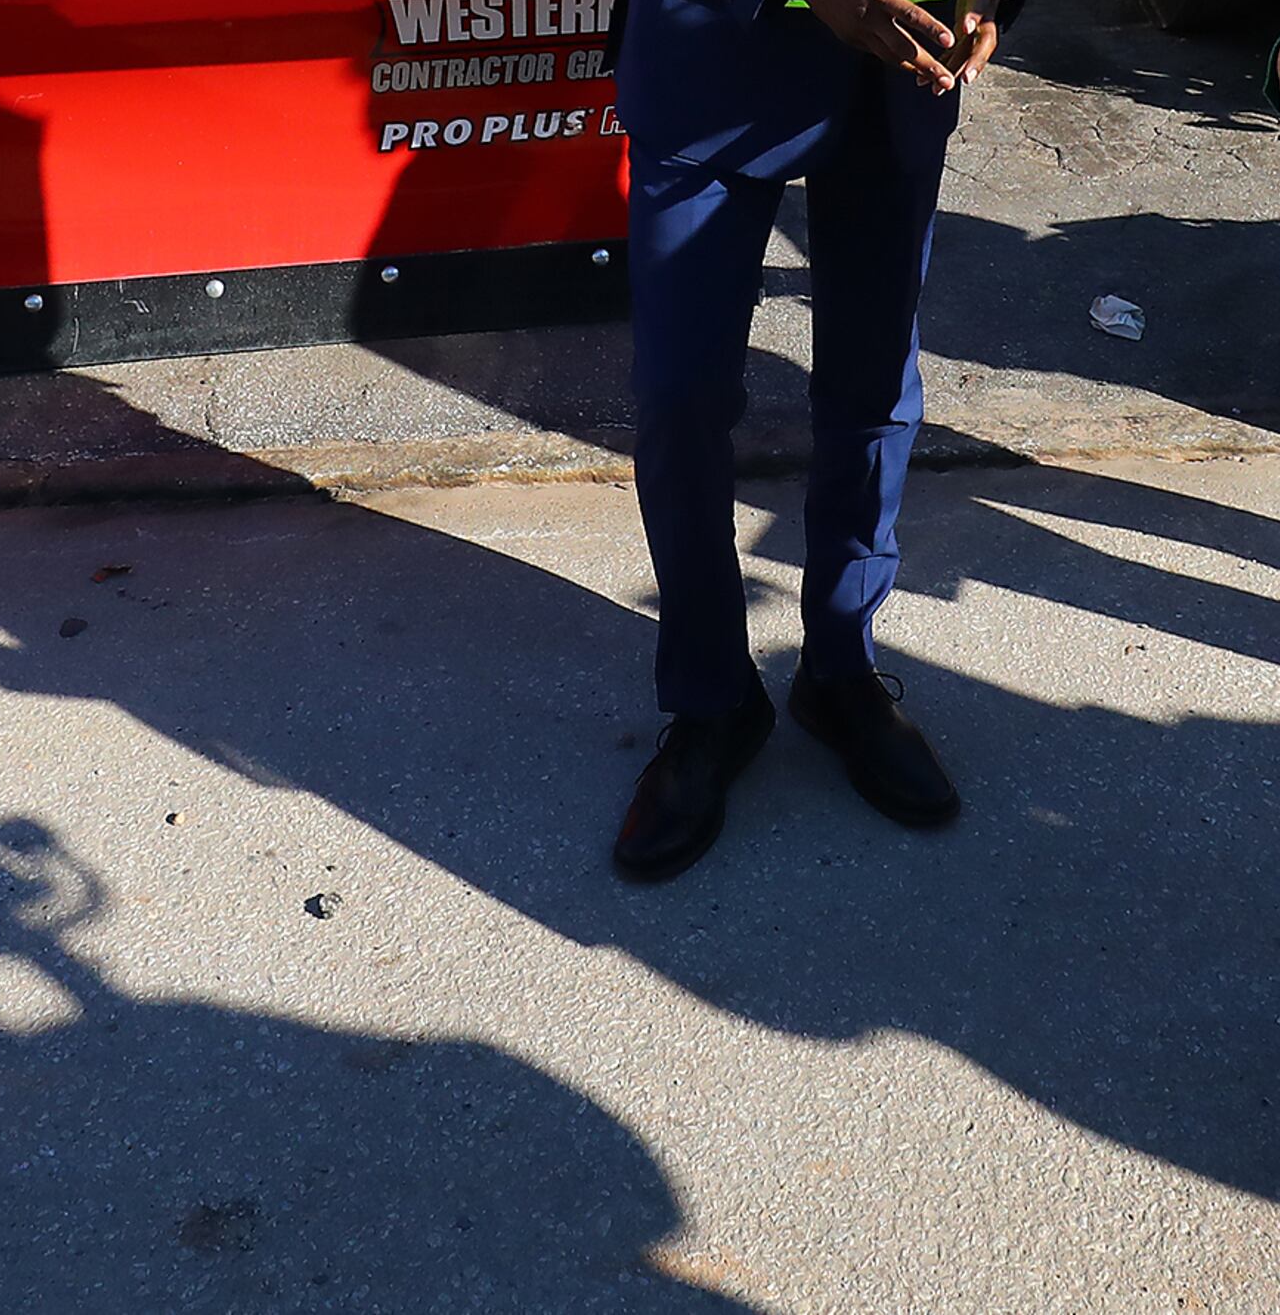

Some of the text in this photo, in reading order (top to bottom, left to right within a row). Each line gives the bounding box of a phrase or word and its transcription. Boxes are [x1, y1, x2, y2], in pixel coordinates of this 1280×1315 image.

[371, 52, 555, 93] CONTRACTOR
[381, 119, 473, 151] PRO
[481, 109, 586, 143] PLUS
